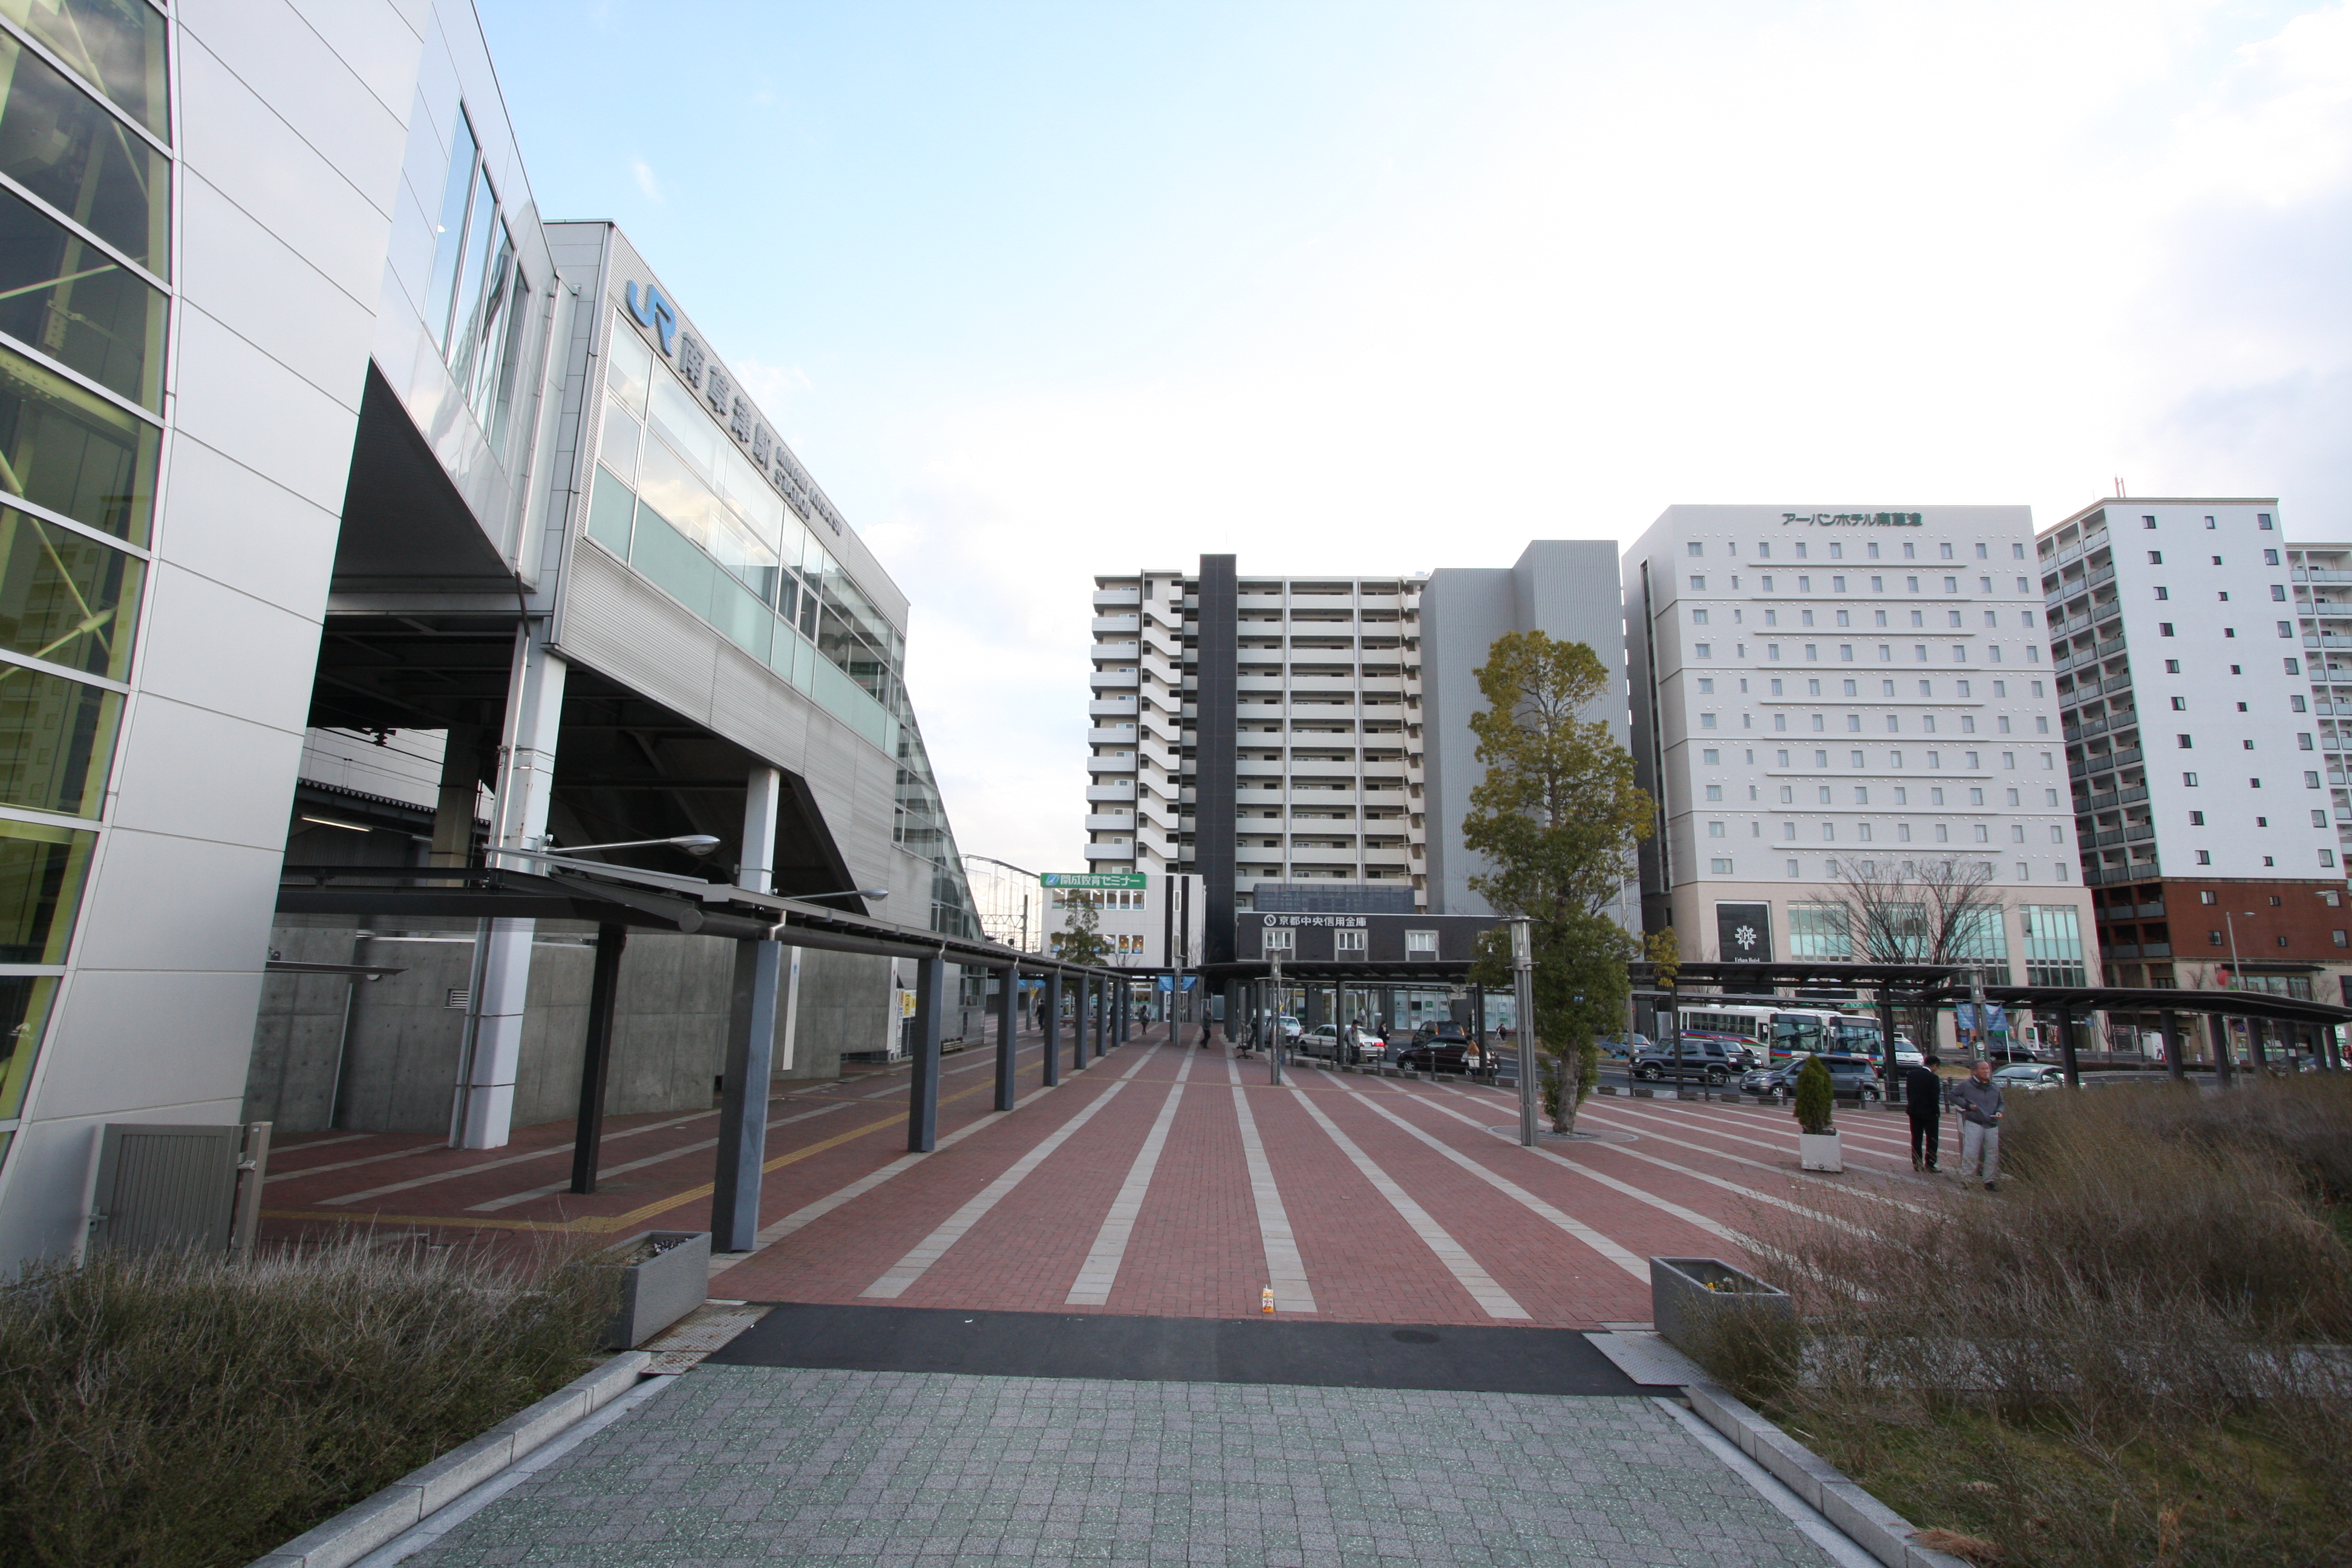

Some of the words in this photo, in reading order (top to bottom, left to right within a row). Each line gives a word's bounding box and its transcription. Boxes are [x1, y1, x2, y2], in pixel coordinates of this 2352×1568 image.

[627, 280, 677, 357] JR
[679, 331, 773, 470] 南草津駅
[775, 468, 811, 519] STATION
[777, 446, 808, 495] MINAMI
[809, 487, 843, 536] KUSATSU
[1782, 512, 1922, 527] アーバンホテル南草津
[1060, 874, 1140, 886] 開成教育セミナー
[1279, 916, 1367, 927] 京都中央信用金庫
